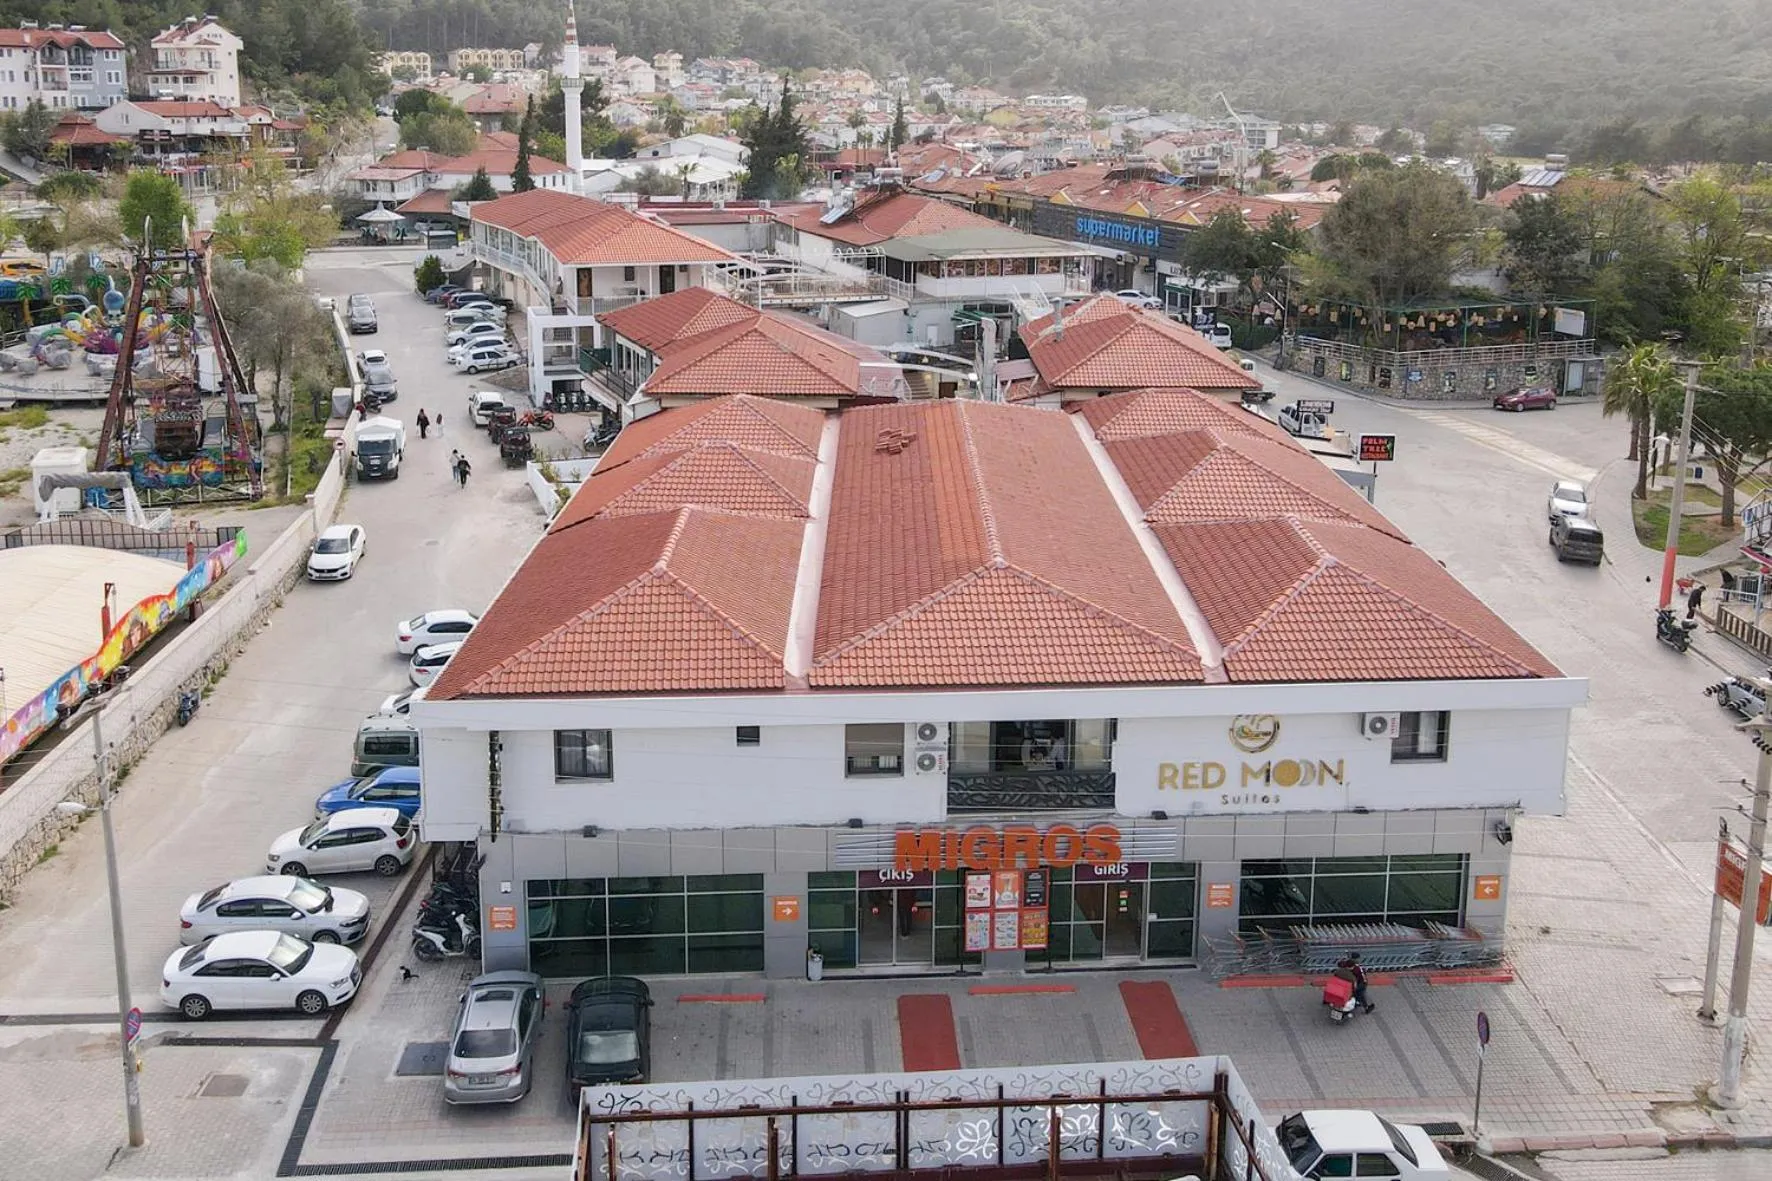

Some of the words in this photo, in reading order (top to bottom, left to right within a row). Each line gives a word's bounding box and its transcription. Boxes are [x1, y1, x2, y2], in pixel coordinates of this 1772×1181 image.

[1076, 217, 1160, 247] supermarket
[1158, 761, 1227, 790] RED
[1240, 758, 1344, 788] MOON
[895, 824, 1122, 871] MIGROS
